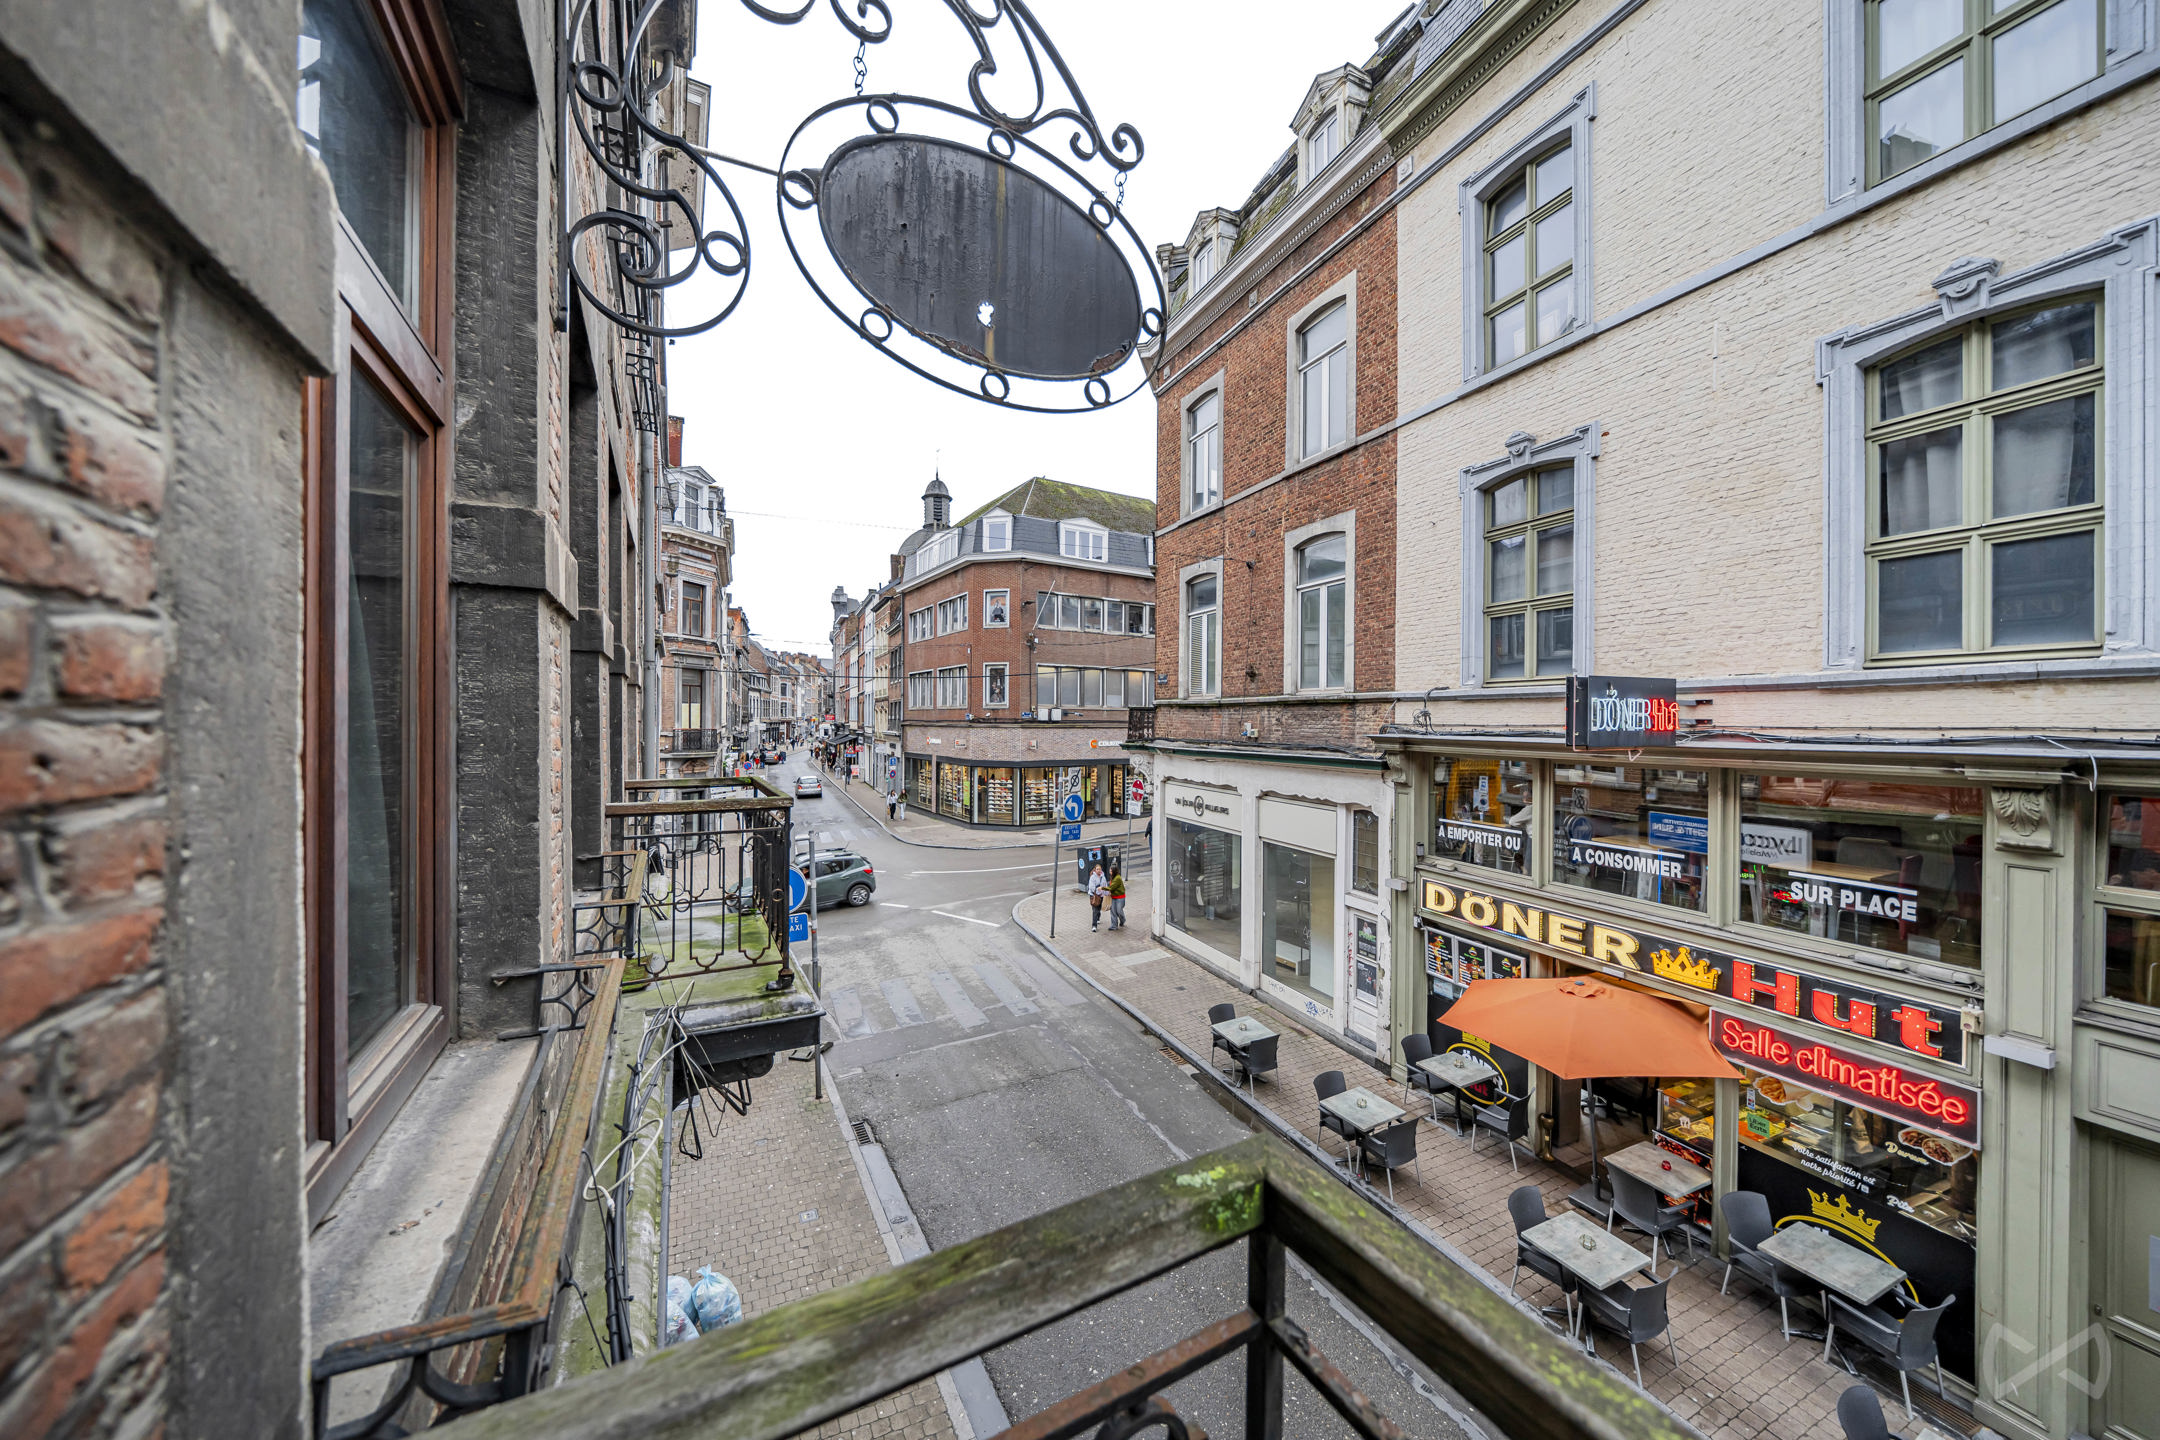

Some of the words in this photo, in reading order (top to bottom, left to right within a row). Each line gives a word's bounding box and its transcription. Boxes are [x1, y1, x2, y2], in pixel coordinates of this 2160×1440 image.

[1591, 689, 1651, 731] DÖNER
[1438, 825, 1445, 838] A
[1447, 826, 1502, 848] EMPORTER
[1505, 836, 1521, 851] OU
[1572, 847, 1582, 862] A
[1586, 848, 1682, 879] CONSOMMER
[1790, 881, 1833, 906] SUR
[1840, 889, 1918, 922] PLACE
[1425, 882, 1641, 970] DÖNER
[1732, 959, 1943, 1058] Hut
[1722, 1018, 1790, 1065] Salle
[1795, 1045, 1968, 1125] climatisée
[1800, 1159, 1823, 1173] notre
[1822, 1168, 1856, 1188] priorité
[1815, 1155, 1862, 1180] satisfaction
[1862, 1175, 1877, 1186] est
